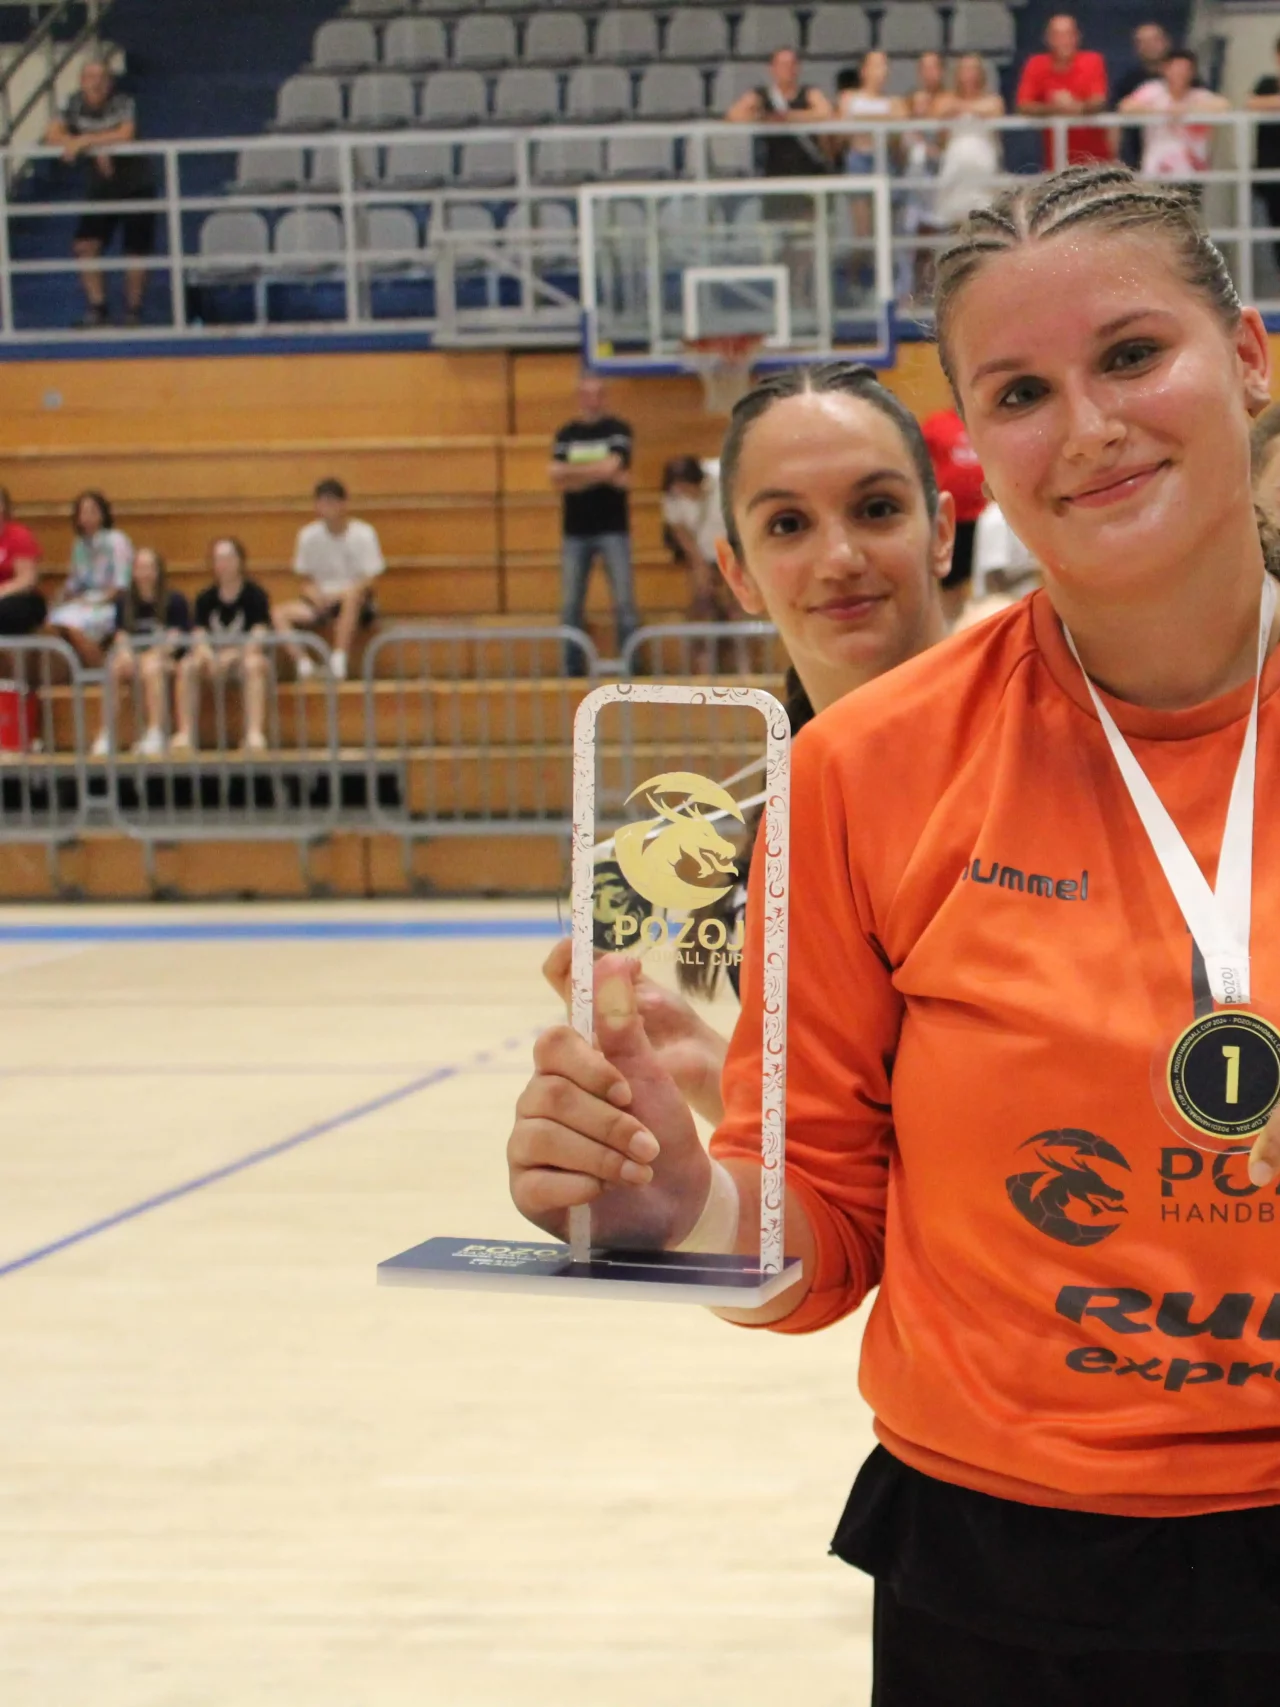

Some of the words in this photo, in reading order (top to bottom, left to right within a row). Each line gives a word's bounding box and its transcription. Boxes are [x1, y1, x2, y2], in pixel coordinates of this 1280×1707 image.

[614, 915, 745, 951] POZOJ
[711, 952, 744, 966] CUP
[1222, 1045, 1240, 1104] 1
